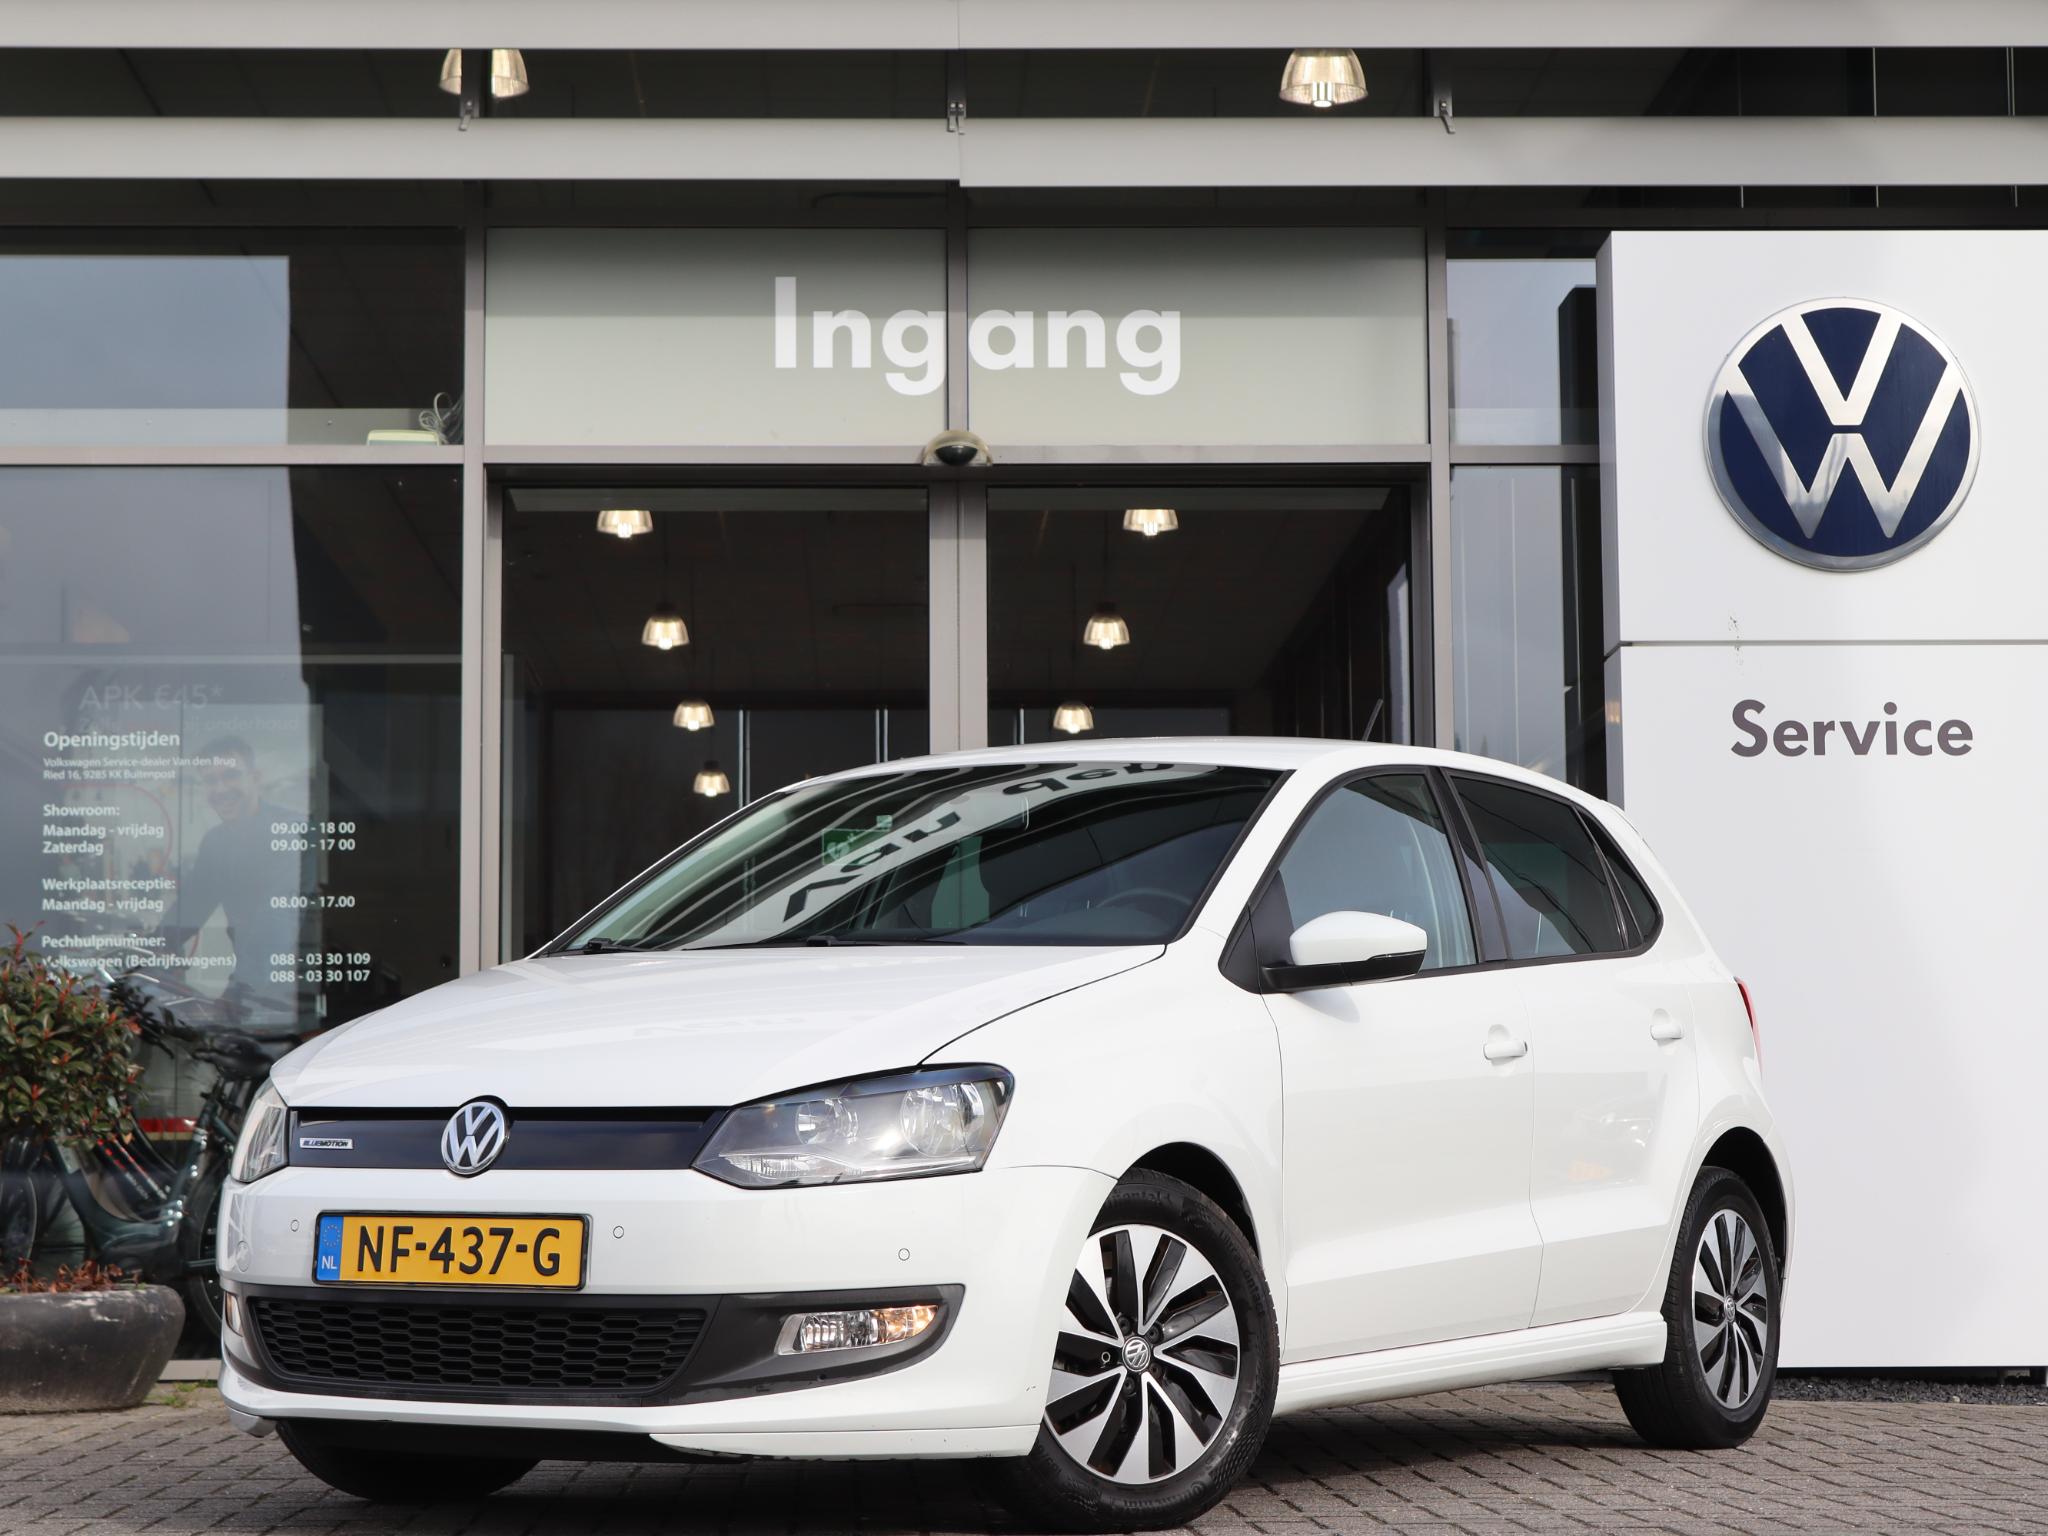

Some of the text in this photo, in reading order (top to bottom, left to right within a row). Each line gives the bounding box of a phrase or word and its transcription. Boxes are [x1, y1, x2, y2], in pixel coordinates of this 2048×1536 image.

[775, 276, 1181, 396] Ingang
[78, 684, 144, 710] APK
[1730, 698, 1974, 757] Service
[44, 731, 181, 750] Openingstijden
[43, 757, 101, 769] Volkswagen
[172, 757, 190, 767] Van
[192, 757, 211, 767] den
[213, 757, 236, 769] Brug
[43, 770, 65, 780] Ried
[124, 770, 176, 781] Buitenpost
[43, 804, 120, 816] Showroom:
[43, 824, 106, 838] Maandag
[117, 824, 164, 838] vrijdag
[271, 822, 308, 834] 09.00
[43, 841, 104, 855] Zaterdag
[271, 839, 308, 851] 09.00
[42, 878, 176, 892] Werkplaatsreceptie:
[42, 899, 105, 913] Maandag
[116, 898, 164, 912] vrijdag
[270, 896, 308, 908] 08.00
[319, 896, 356, 908] 17.00
[42, 935, 166, 949] Pechhulpnummer:
[125, 954, 237, 969] (Bedrijfswagens)
[270, 953, 296, 965] 088
[306, 953, 323, 965] 03
[326, 953, 343, 965] 30
[346, 953, 371, 965] 109
[270, 970, 296, 982] 088
[306, 970, 323, 982] 03
[326, 970, 343, 982] 30
[346, 970, 371, 982] 107
[357, 1225, 561, 1276] NF-437-G
[321, 1255, 337, 1270] NL
